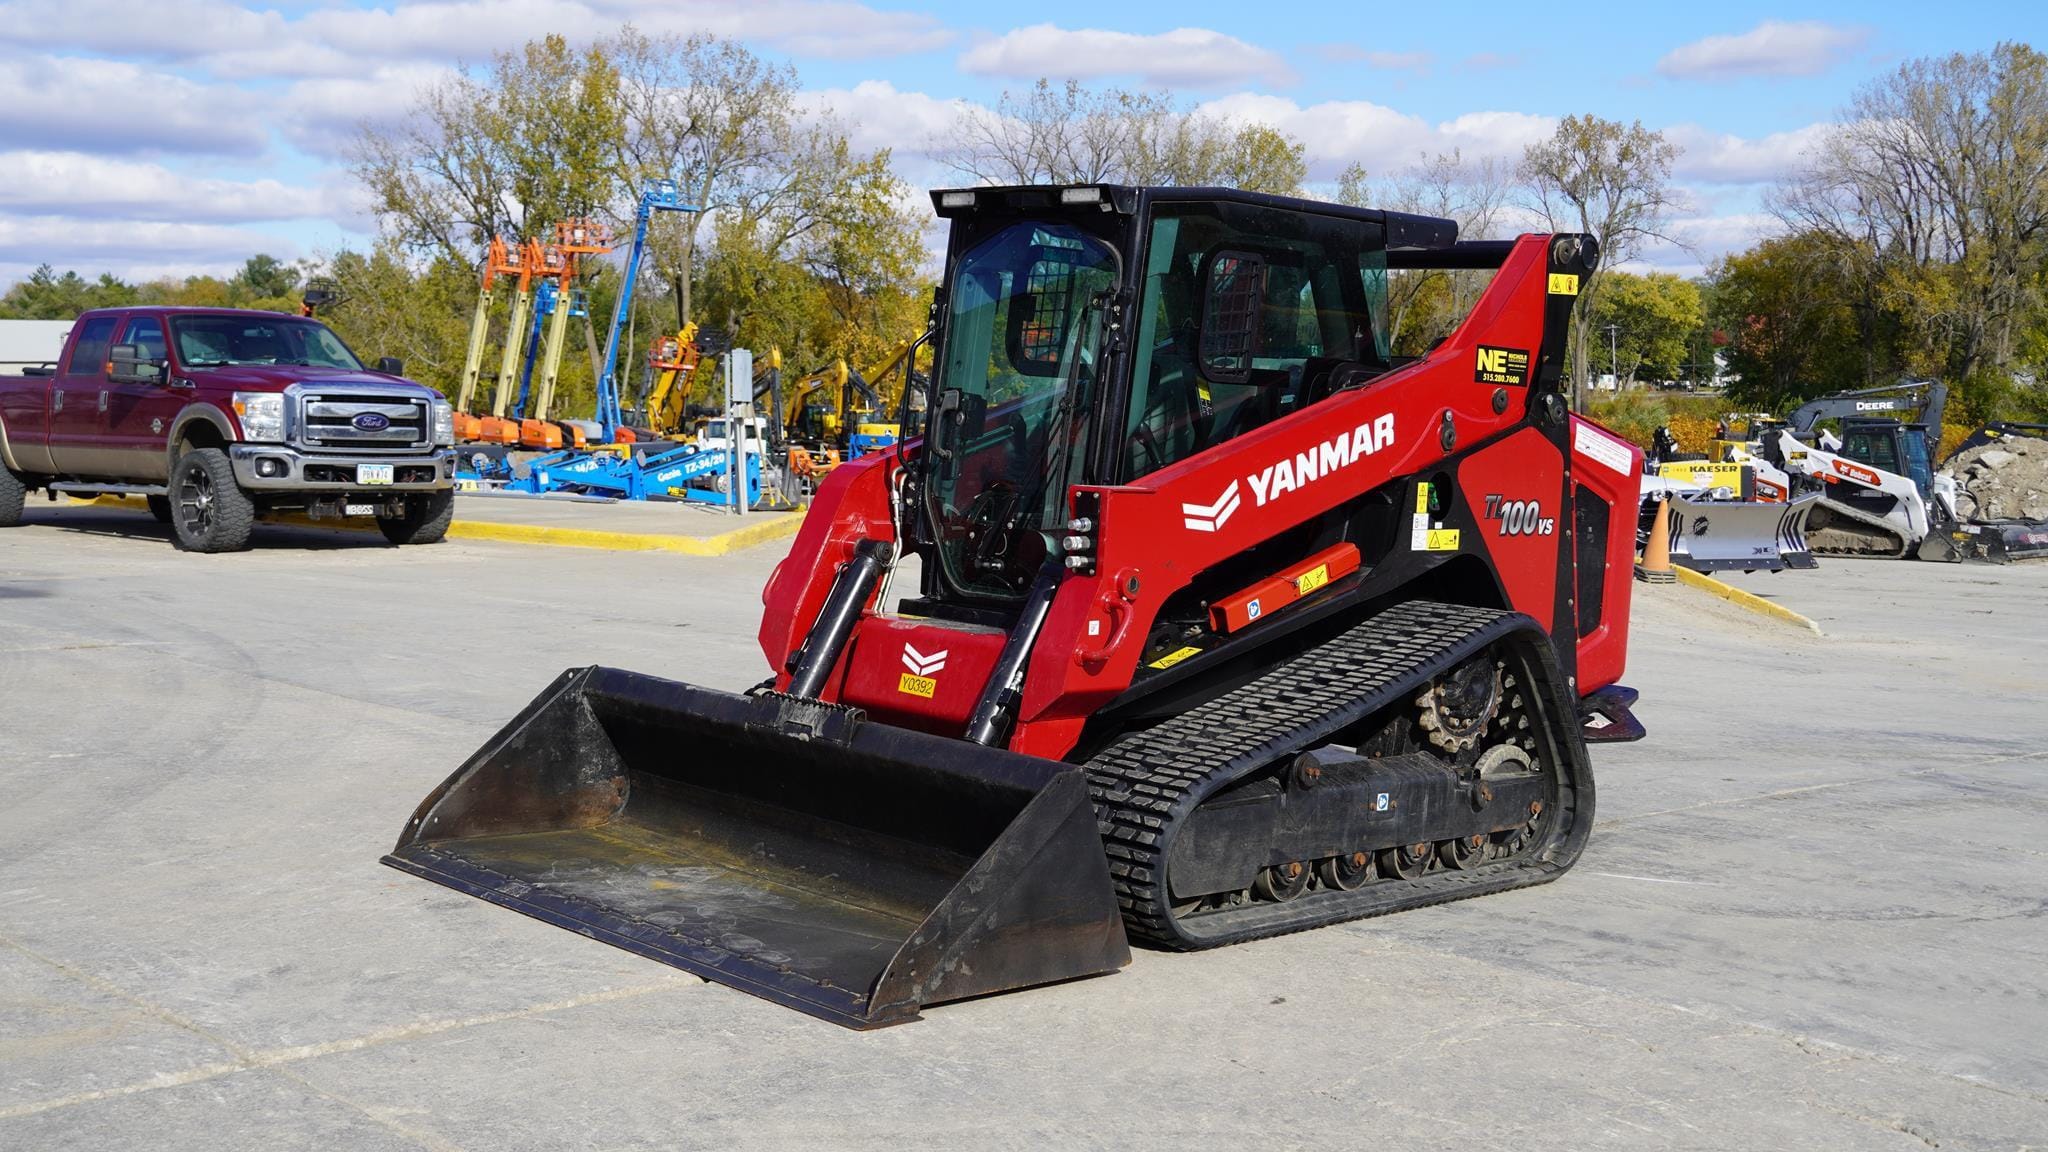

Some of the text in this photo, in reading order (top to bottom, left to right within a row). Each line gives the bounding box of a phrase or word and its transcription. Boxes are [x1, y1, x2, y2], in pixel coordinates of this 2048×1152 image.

[1477, 348, 1507, 373] NE
[1856, 402, 1894, 411] DEERE
[361, 416, 383, 427] Ford
[1247, 412, 1395, 507] YANMAR
[657, 453, 726, 483] Genie TZ-34/20
[1689, 465, 1738, 473] KAESER
[1849, 469, 1872, 482] Bobcat
[903, 676, 933, 694] Y0392
